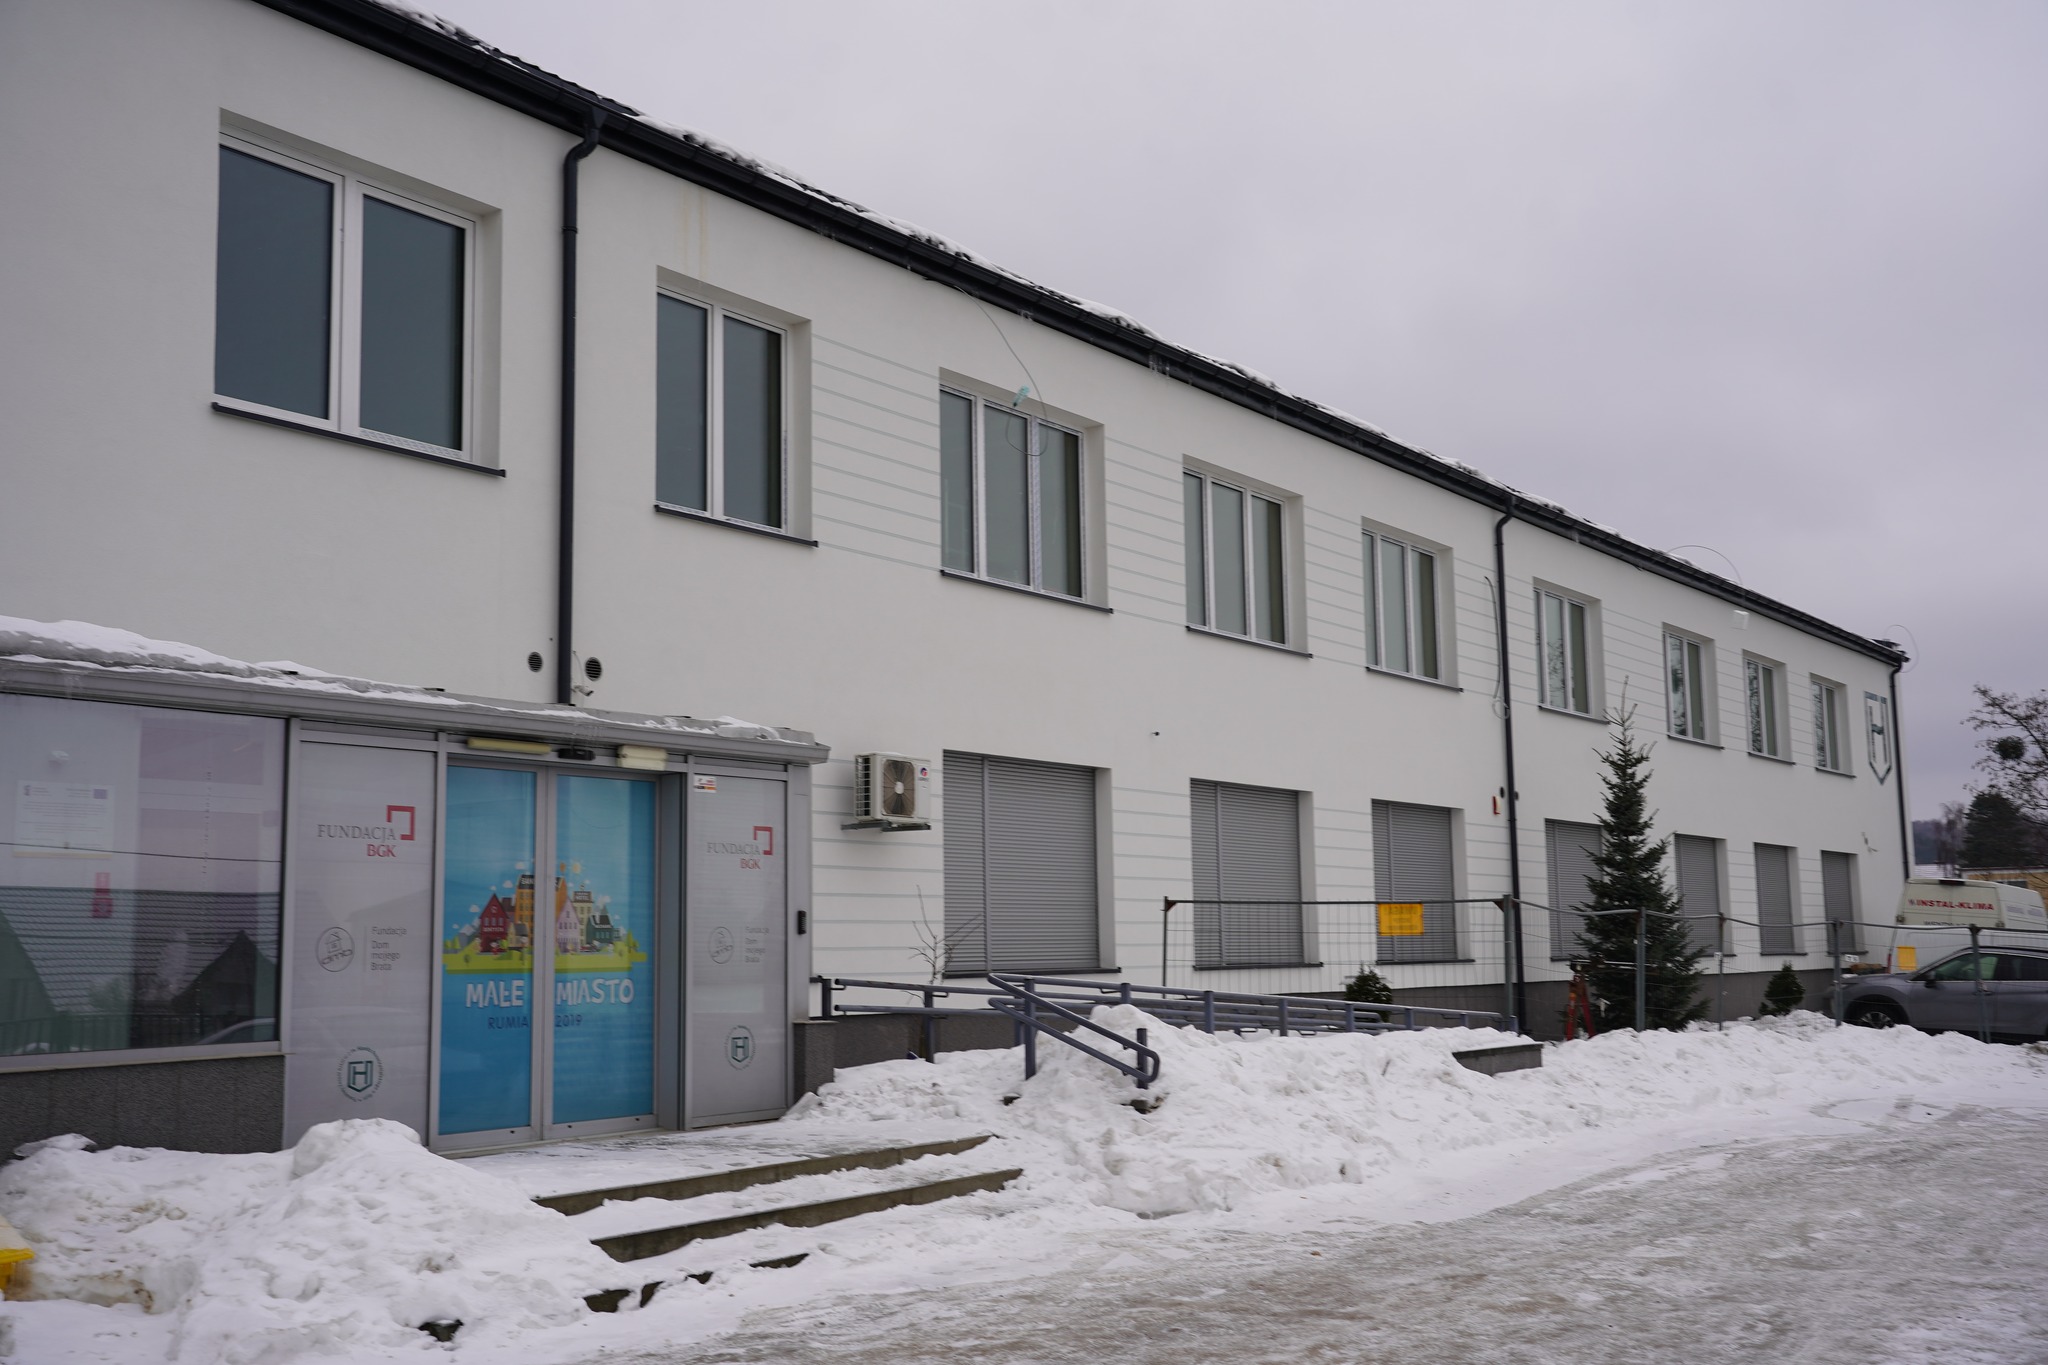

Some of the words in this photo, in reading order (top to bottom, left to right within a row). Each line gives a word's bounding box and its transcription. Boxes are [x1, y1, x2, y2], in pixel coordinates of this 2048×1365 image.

[317, 824, 397, 842] FUNDACJA
[366, 843, 397, 858] BGK
[706, 842, 761, 857] FUNDACJA
[739, 858, 761, 870] BGK
[1916, 899, 1994, 911] INSTAL-KLIMA
[371, 925, 408, 937] Fundacja
[371, 940, 390, 949] Dom
[466, 979, 525, 1009] MAŁE
[556, 978, 635, 1006] MIASTO
[487, 1015, 529, 1030] RUMIA
[555, 1014, 583, 1029] 2019
